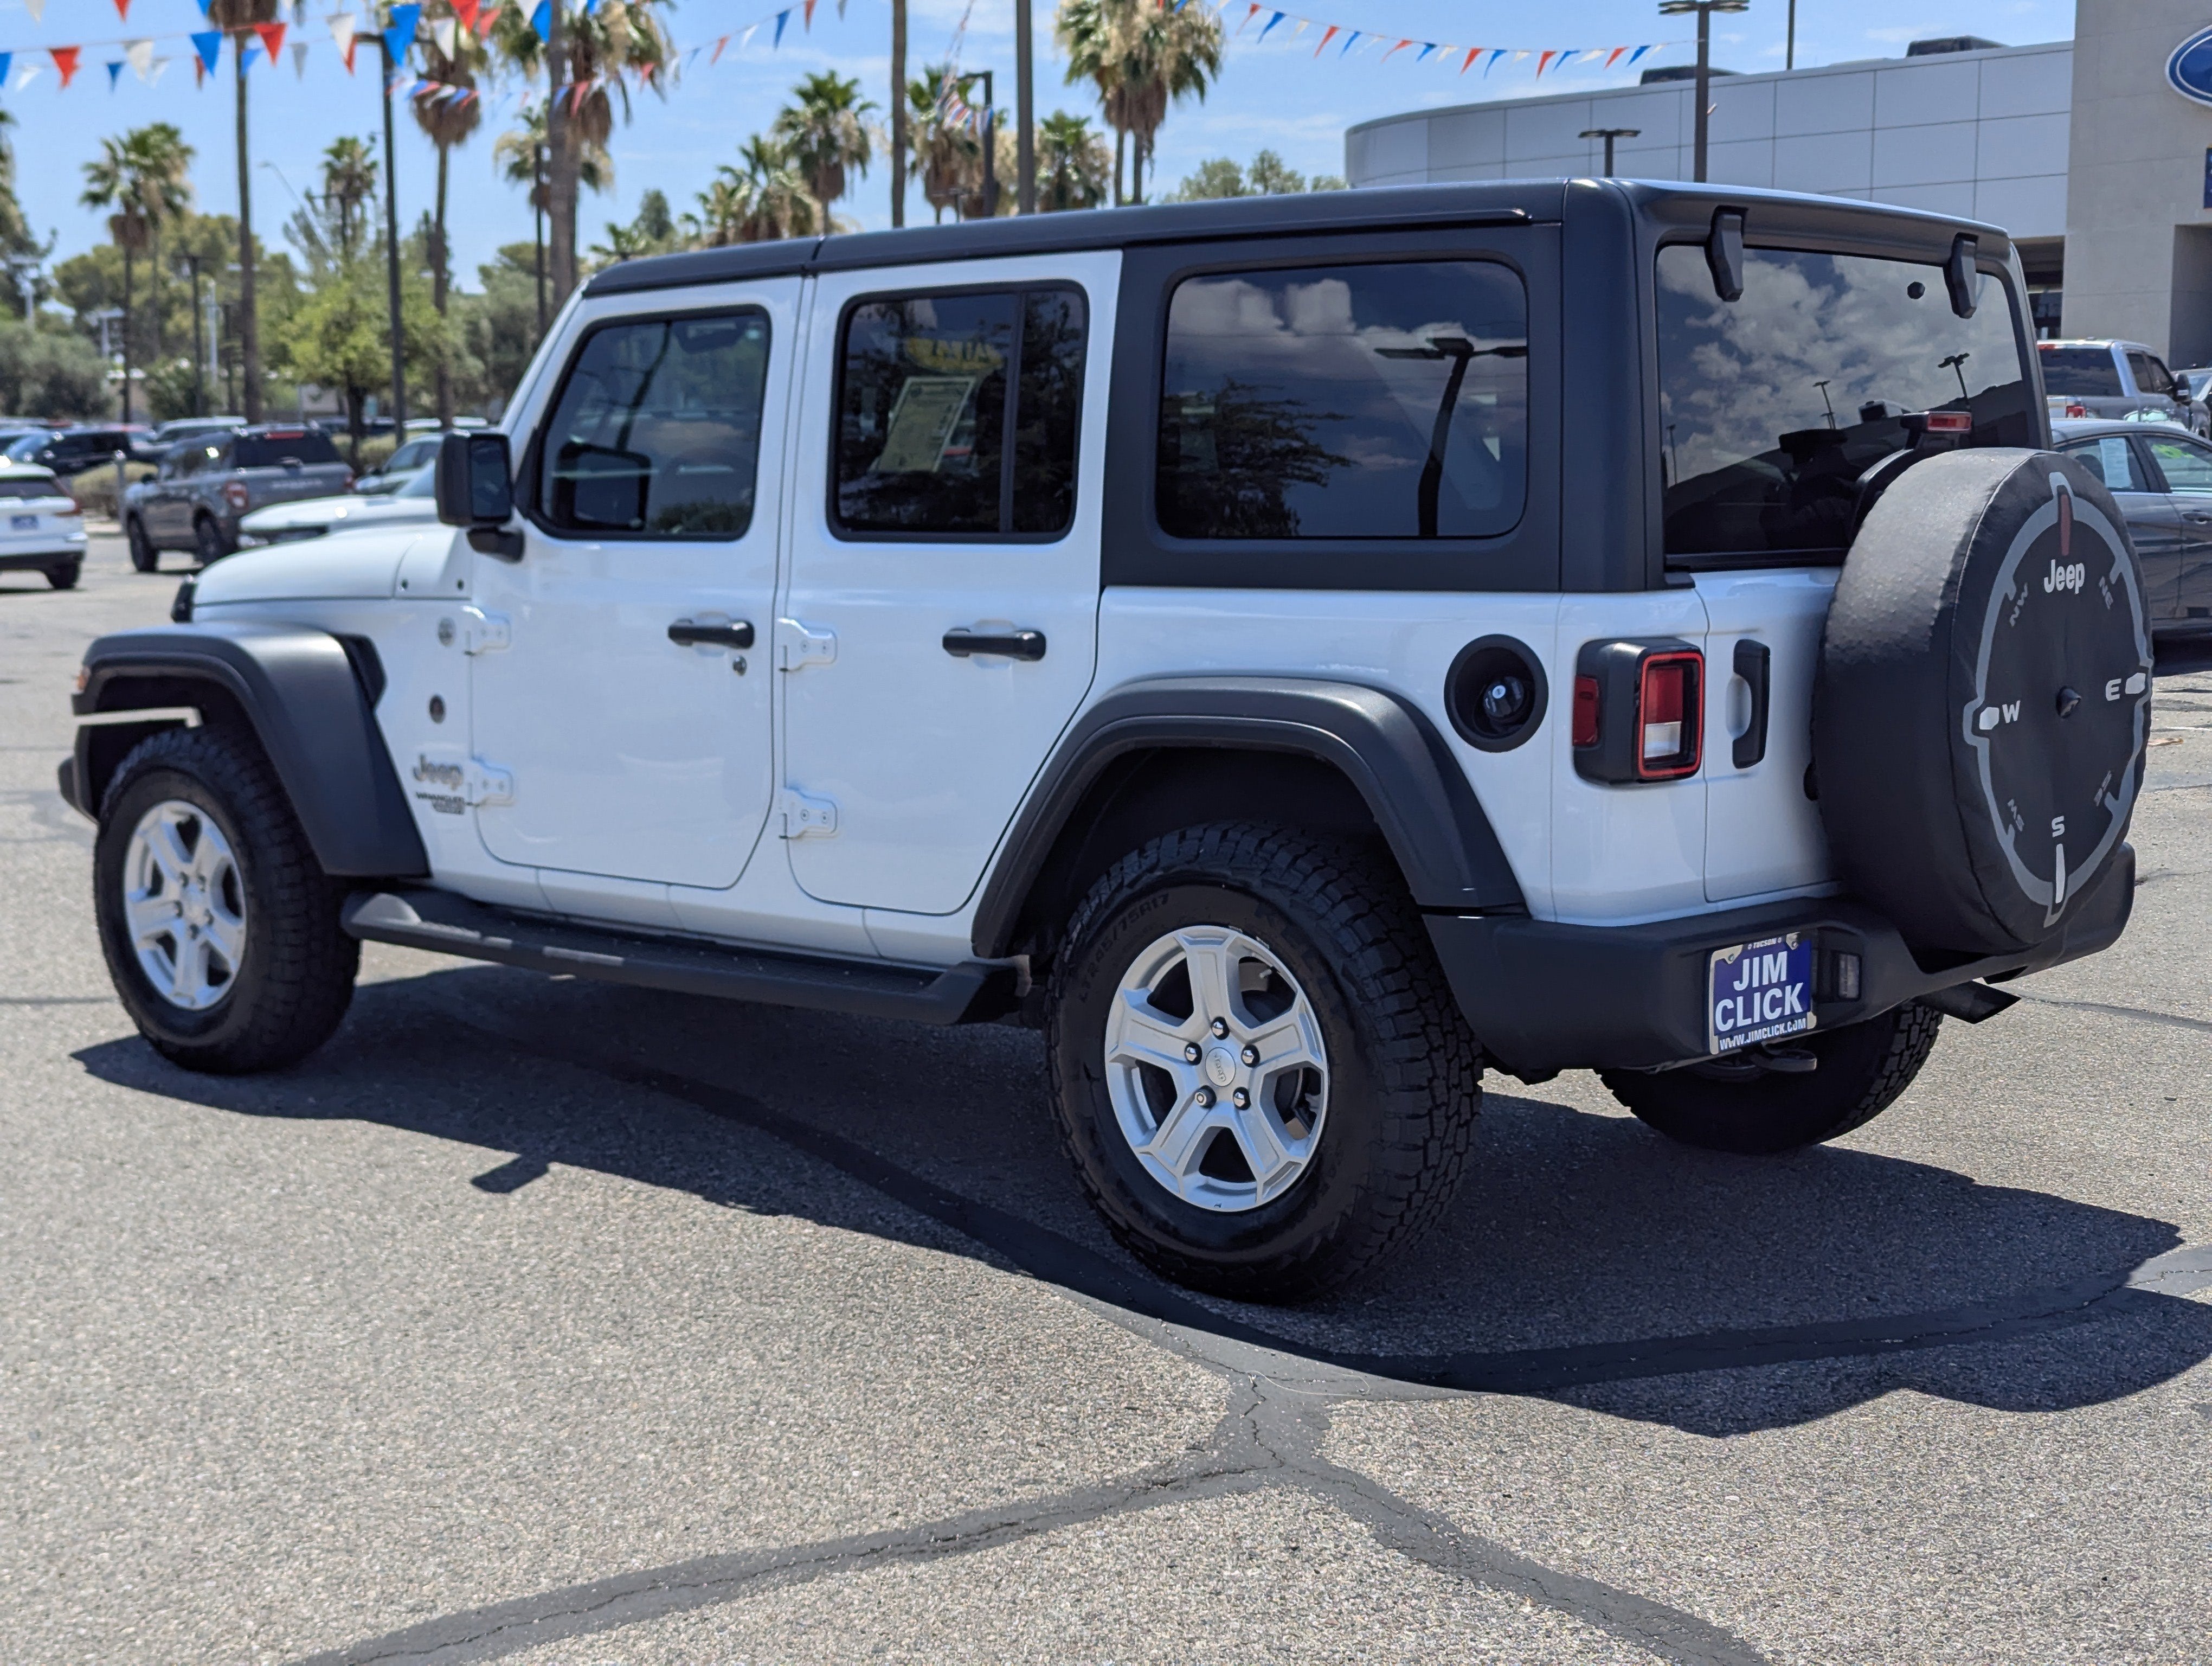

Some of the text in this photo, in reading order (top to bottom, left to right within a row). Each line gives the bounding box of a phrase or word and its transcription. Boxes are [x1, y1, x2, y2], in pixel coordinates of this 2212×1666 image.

[2044, 559, 2085, 594] Jeep
[2099, 575, 2113, 610] NE
[2009, 582, 2028, 626] NW
[2105, 678, 2122, 701] E
[2002, 700, 2021, 723] W
[412, 754, 463, 790] Jeep
[2052, 816, 2065, 837] S
[1753, 937, 1777, 949] TUCSON
[1733, 951, 1787, 991] JIM
[1715, 982, 1804, 1031] CLICK
[1719, 1017, 1806, 1050] WWW.JIMCLICK.COM
[1214, 1052, 1226, 1082] Jeep
